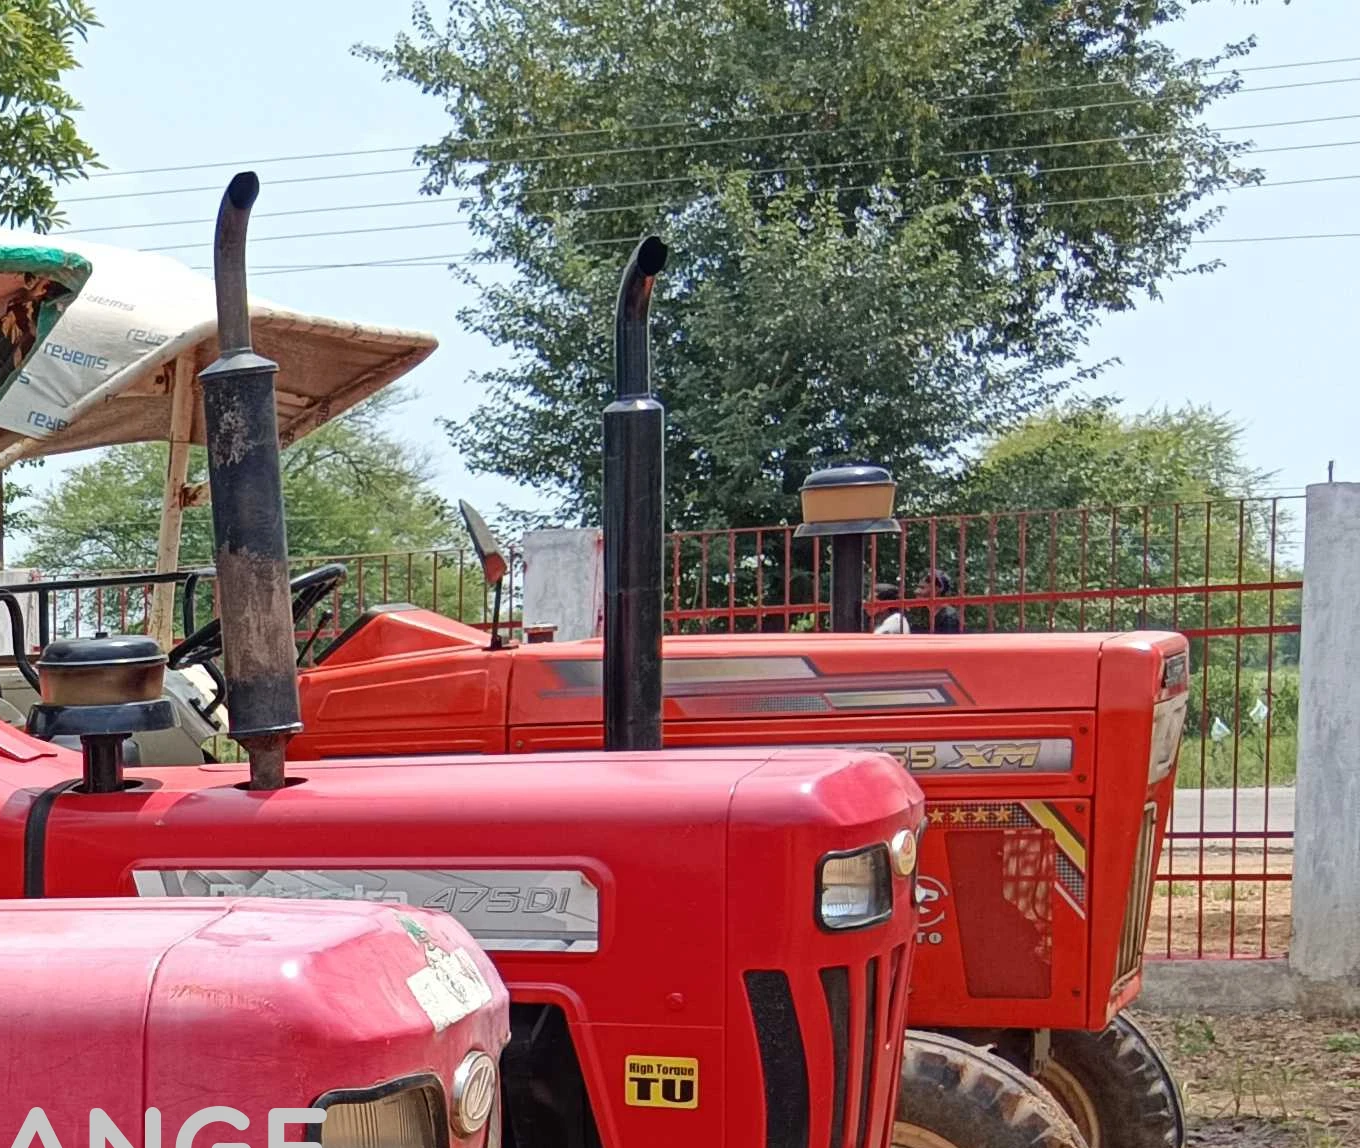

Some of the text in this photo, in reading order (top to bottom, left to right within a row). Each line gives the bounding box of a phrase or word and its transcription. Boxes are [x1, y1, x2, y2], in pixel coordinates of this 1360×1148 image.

[629, 1062, 695, 1077] High Torque
[629, 1077, 695, 1103] TU
